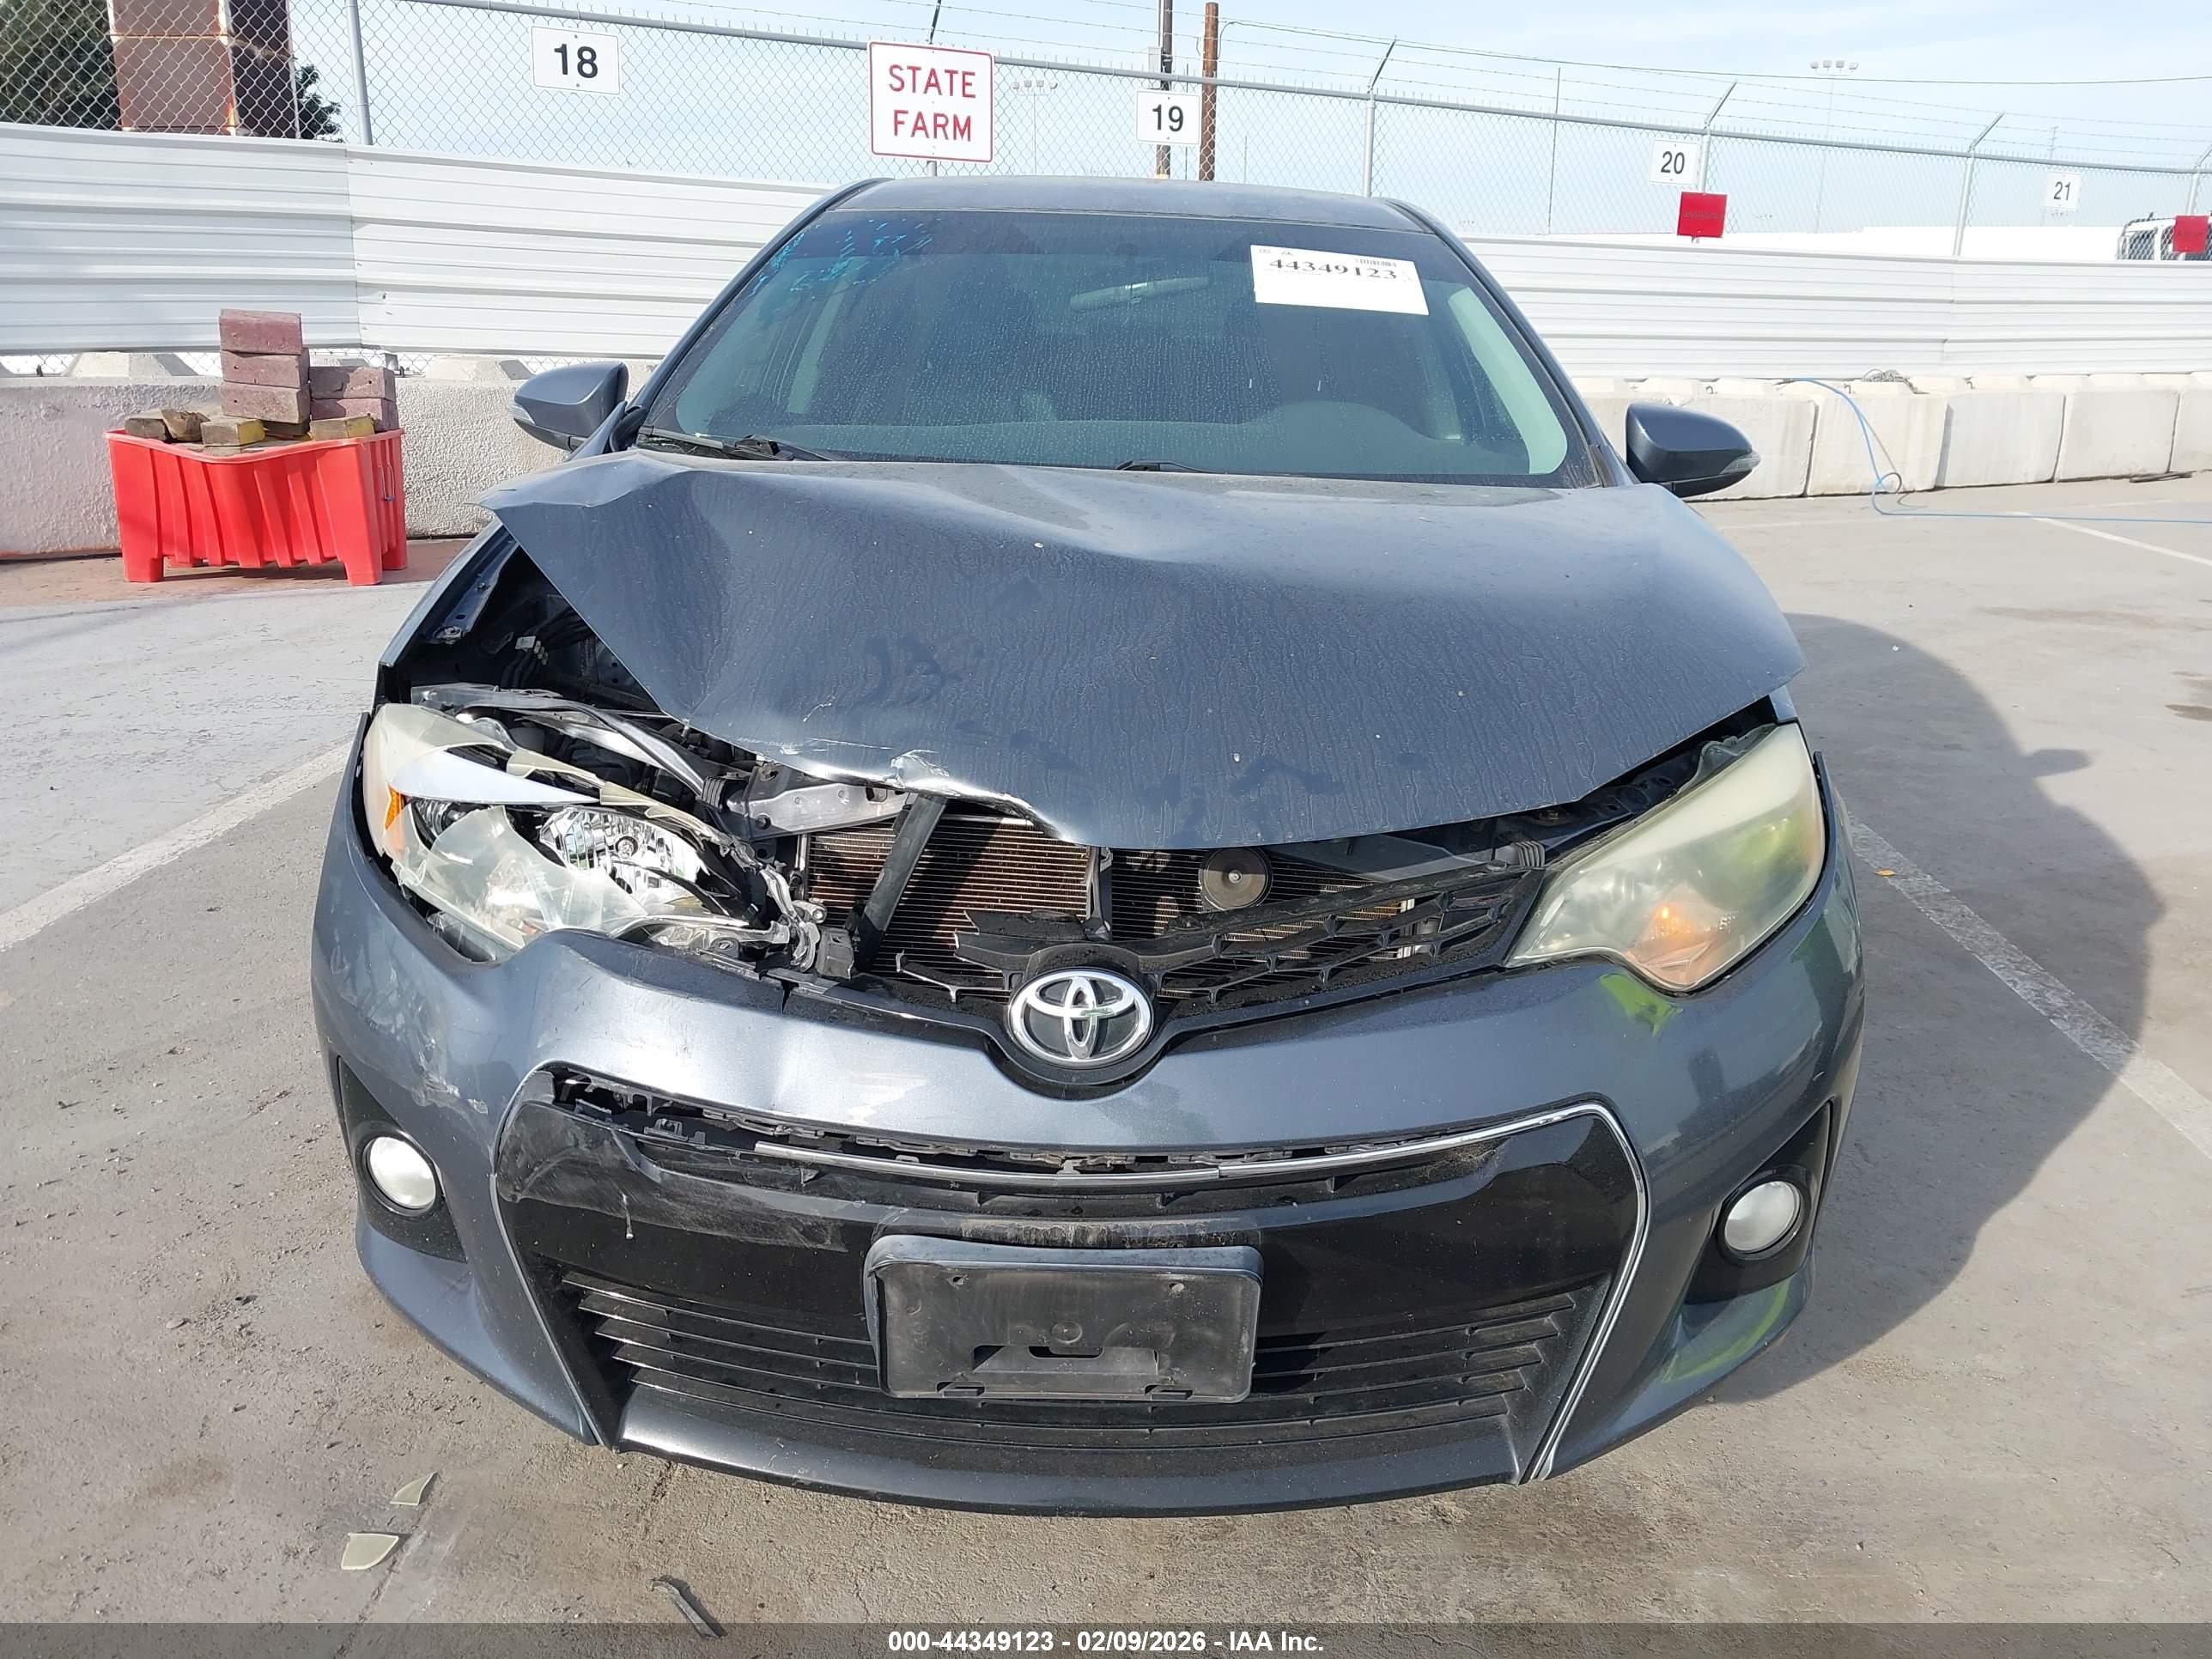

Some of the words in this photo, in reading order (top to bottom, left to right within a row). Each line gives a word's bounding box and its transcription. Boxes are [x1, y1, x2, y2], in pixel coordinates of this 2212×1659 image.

[554, 43, 599, 79] 18
[889, 64, 976, 100] STATE
[893, 109, 973, 143] FARM
[1152, 104, 1184, 132] 19
[1660, 150, 1686, 175] 20
[2053, 180, 2071, 202] 21
[1269, 258, 1397, 280] 44349123
